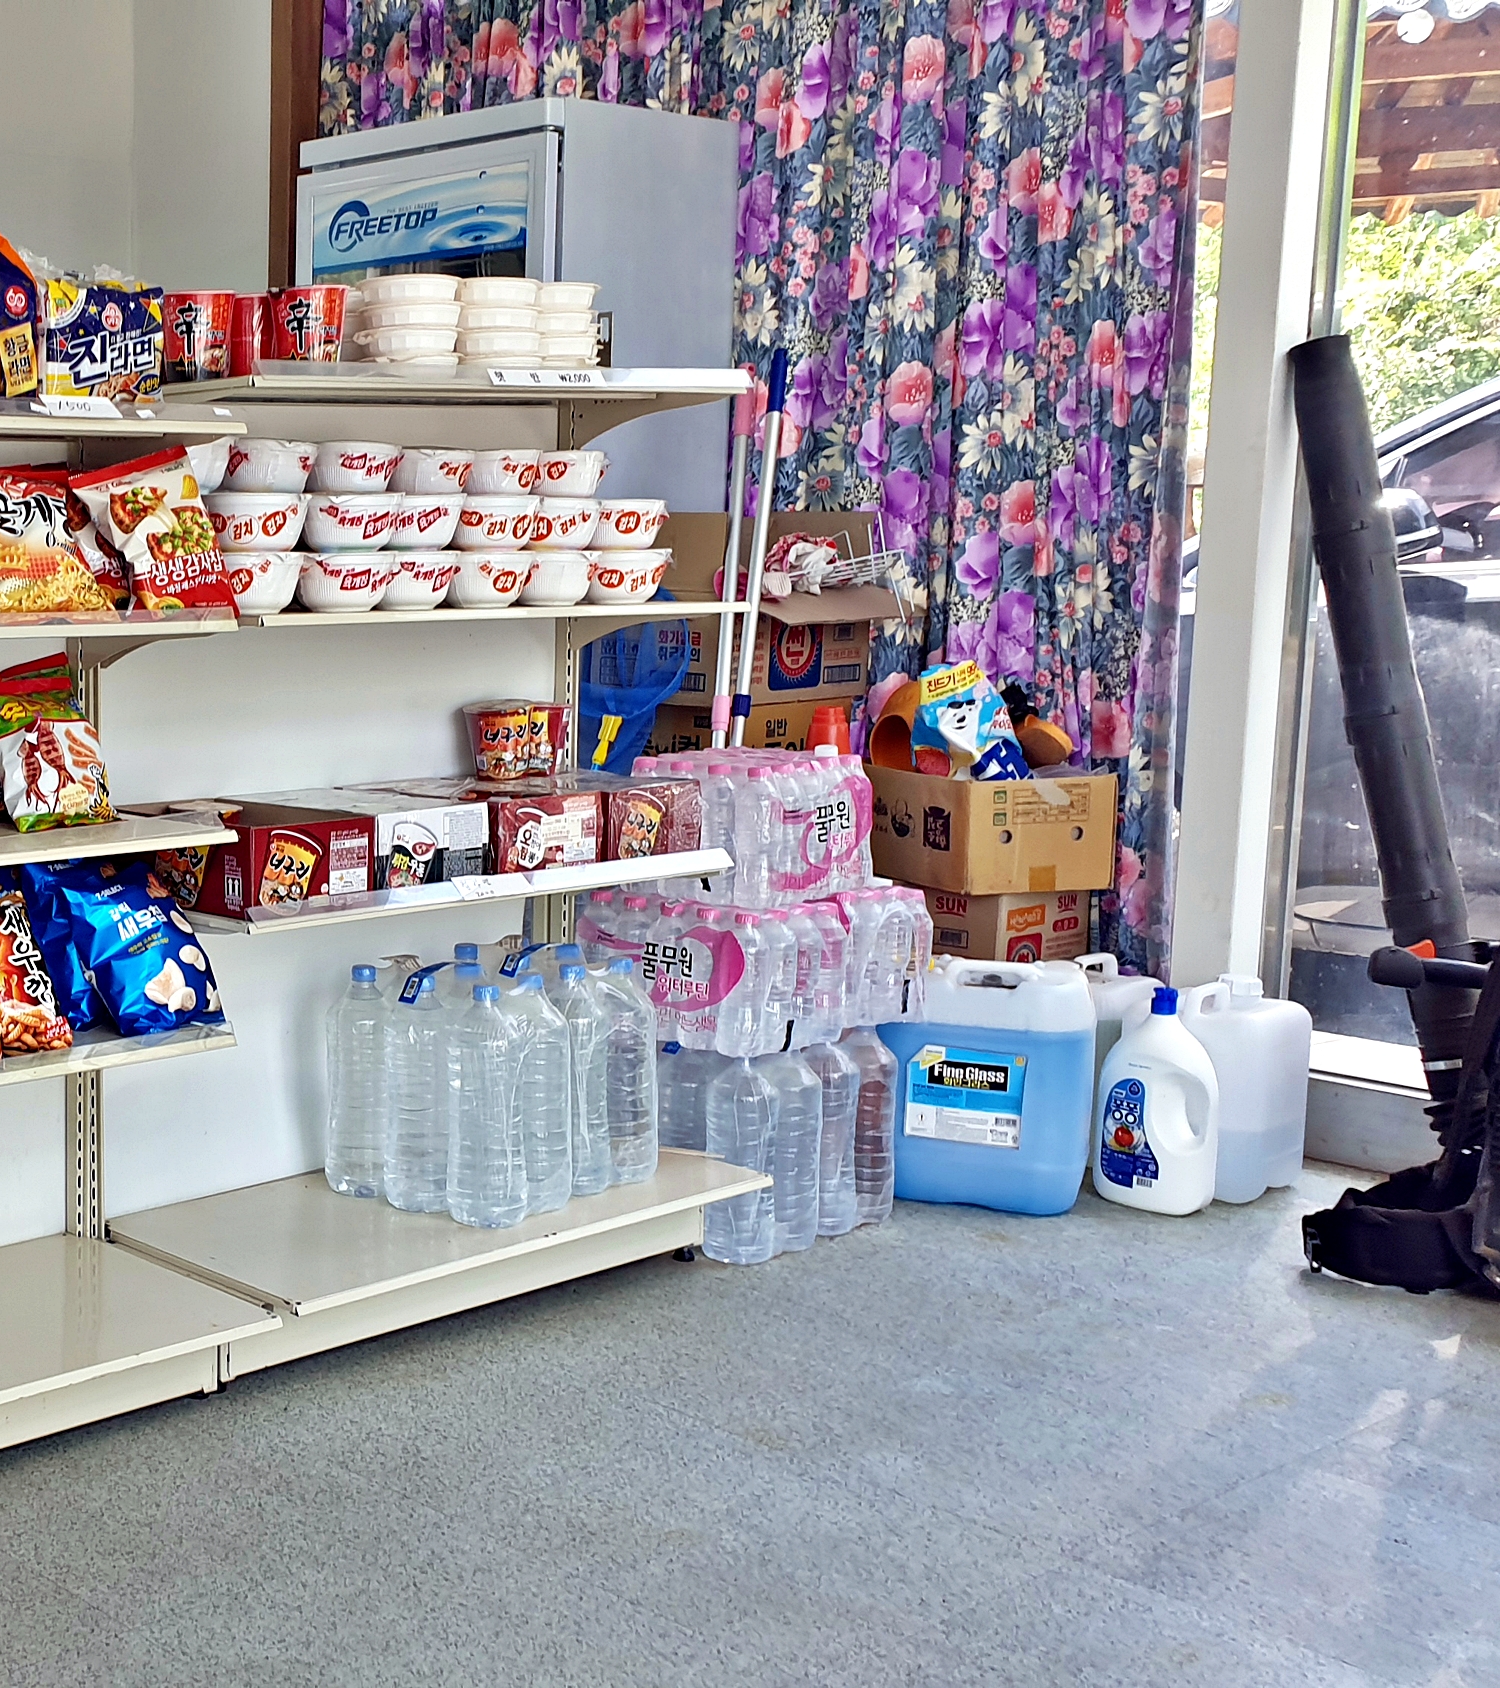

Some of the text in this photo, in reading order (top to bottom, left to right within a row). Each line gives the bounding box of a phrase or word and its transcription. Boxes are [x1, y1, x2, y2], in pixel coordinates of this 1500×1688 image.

[334, 207, 439, 244] FREETOP
[174, 301, 211, 356] 辛
[285, 297, 324, 354] 辛
[4, 334, 30, 357] 황금
[7, 355, 33, 377] 라면
[68, 331, 156, 389] 진라면
[233, 511, 285, 541] 김치 김치
[337, 513, 390, 536] 육개장 육개장
[419, 507, 442, 532] 육개장
[486, 520, 507, 536] 김치
[559, 514, 578, 533] 김치
[619, 514, 637, 533] 김치
[150, 549, 224, 587] 생생감자칩
[230, 571, 249, 591] 김치
[342, 570, 369, 590] 육개장
[496, 572, 517, 592] 김치
[600, 571, 648, 593] 김치 김치
[926, 672, 956, 693] 진드기
[483, 724, 528, 743] 너구리
[764, 719, 788, 739] 일반
[815, 801, 850, 843] 풀무원
[269, 852, 311, 880] 너구리
[935, 895, 968, 914] SUN
[1057, 893, 1078, 910] SUN
[0, 904, 57, 1016] 새우깡
[641, 941, 693, 981] 풀무원
[657, 975, 710, 1001] 워터루틴
[965, 1066, 1006, 1084] Glass
